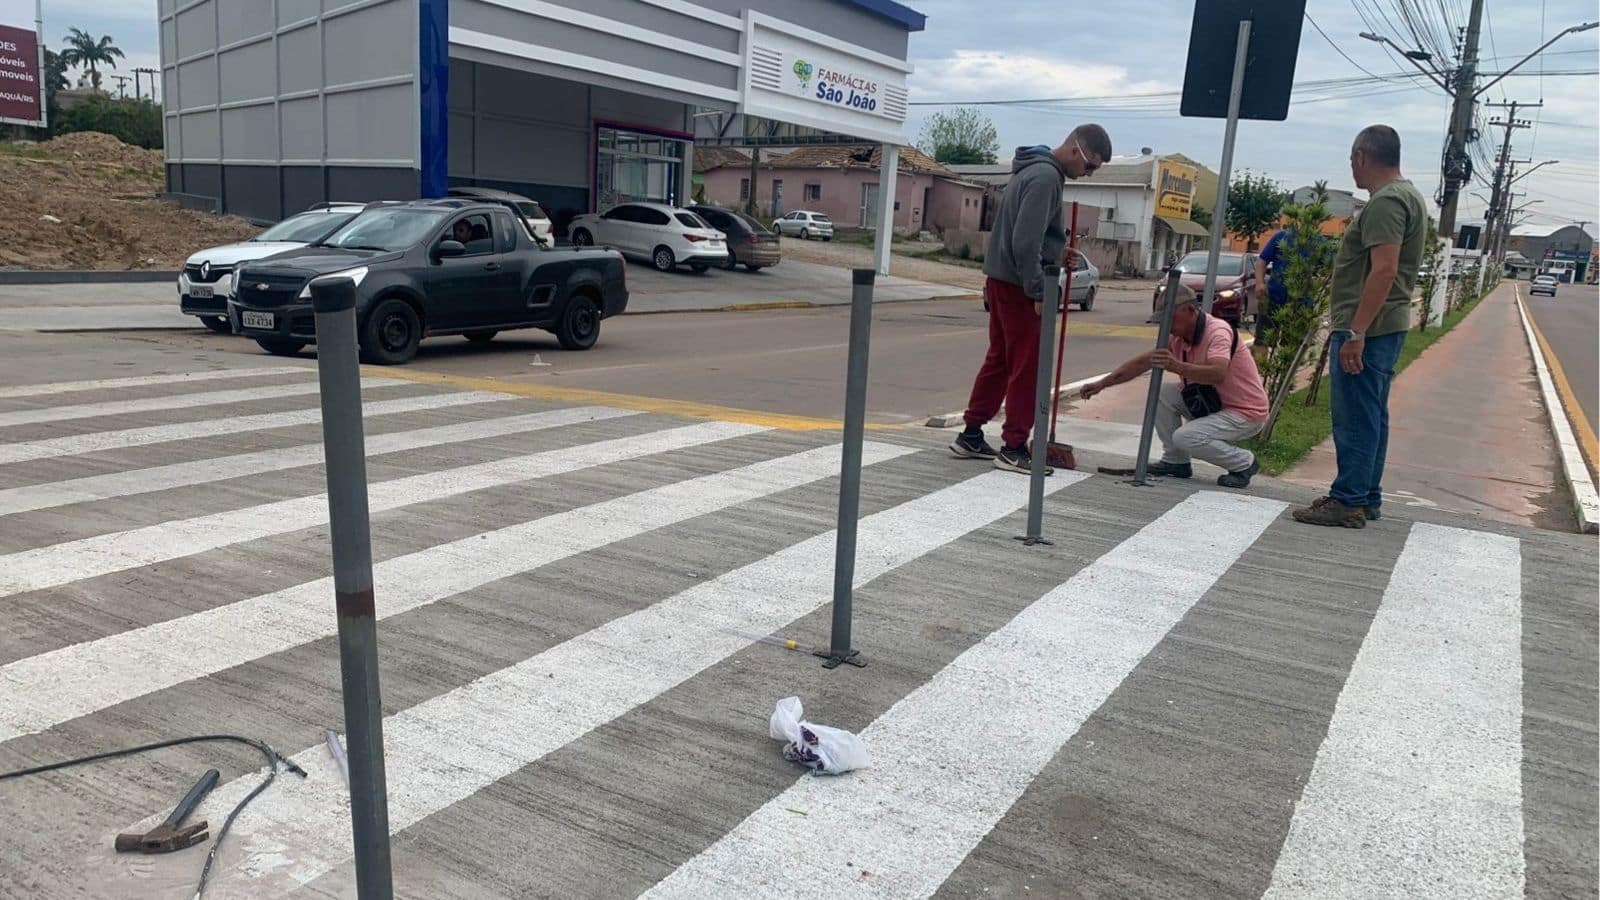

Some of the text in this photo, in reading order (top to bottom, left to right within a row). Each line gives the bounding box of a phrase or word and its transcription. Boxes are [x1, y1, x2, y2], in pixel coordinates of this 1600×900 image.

[817, 68, 877, 93] FARMÁCIAS
[816, 82, 876, 111] São João
